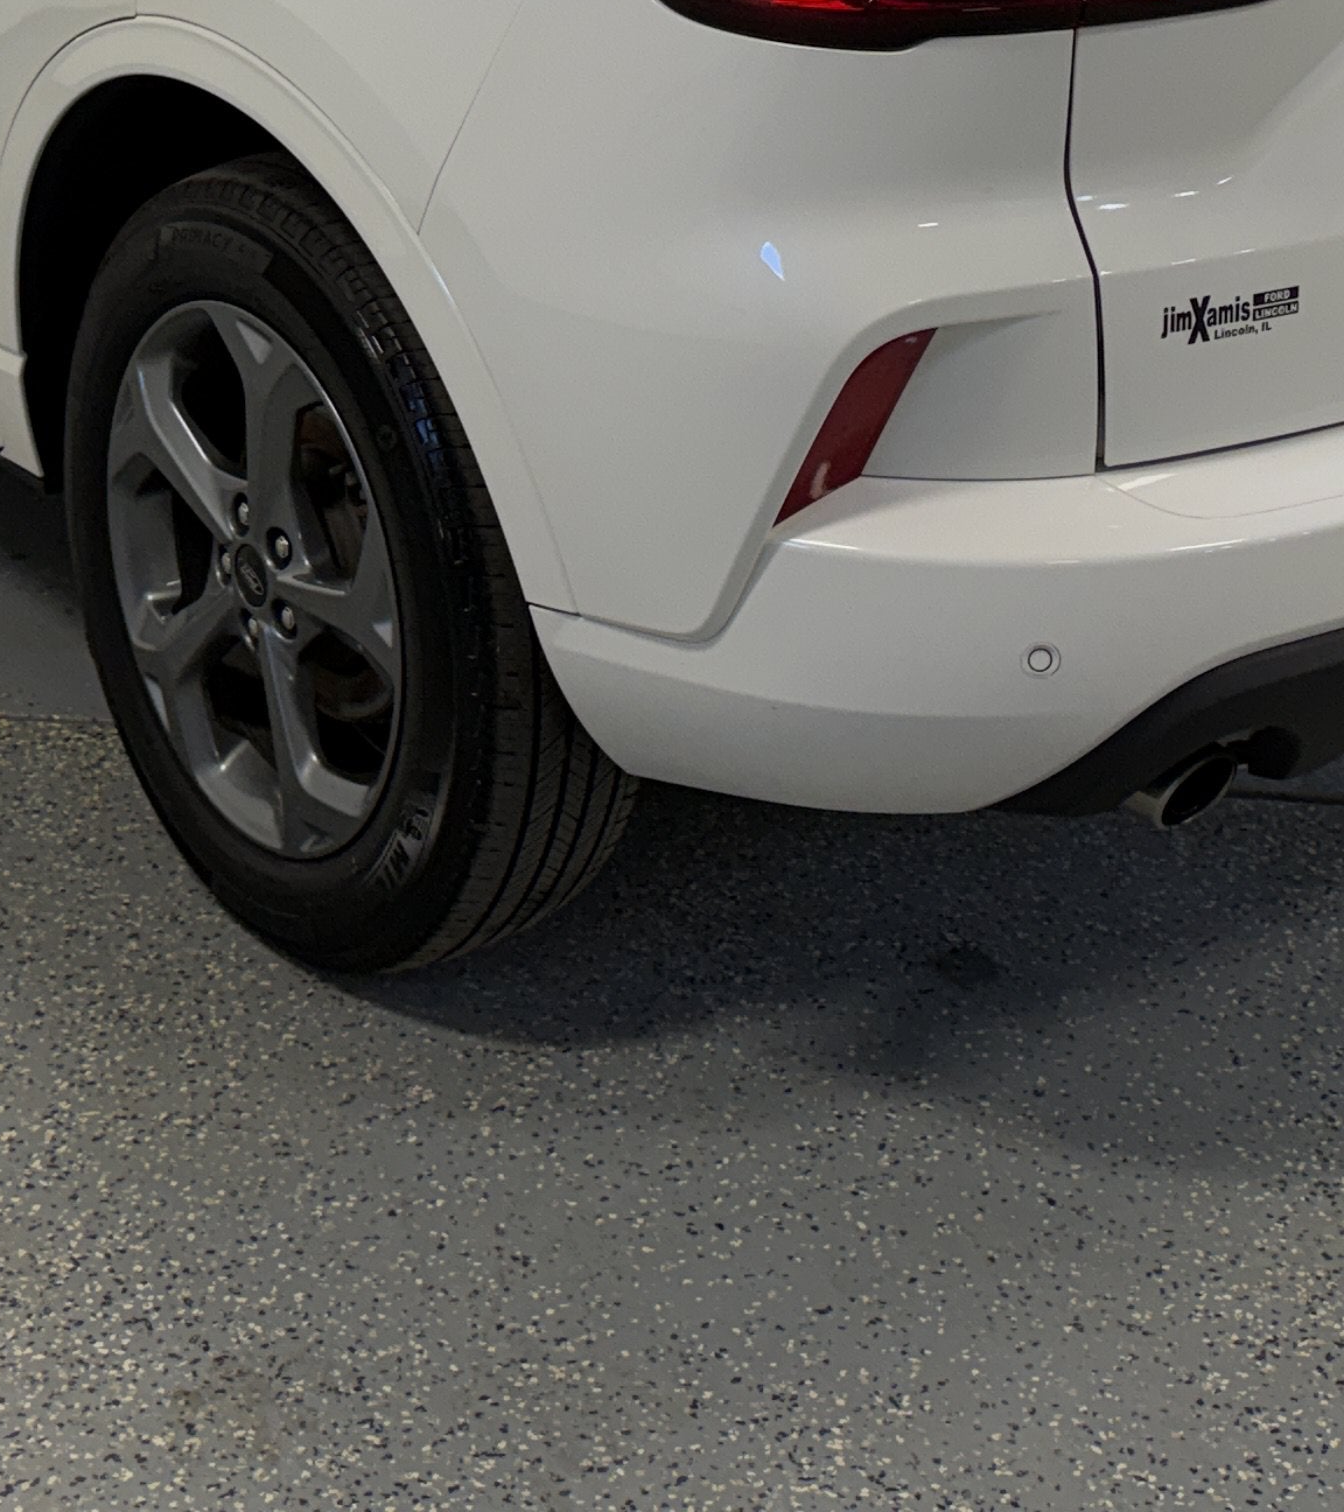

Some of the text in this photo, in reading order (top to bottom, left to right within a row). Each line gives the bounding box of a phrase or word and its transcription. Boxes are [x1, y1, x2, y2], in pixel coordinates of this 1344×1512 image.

[1263, 288, 1292, 303] FORD
[1161, 295, 1251, 345] jimXamis
[1254, 301, 1299, 320] LINCOLN
[1214, 321, 1273, 340] Lincoln, IL
